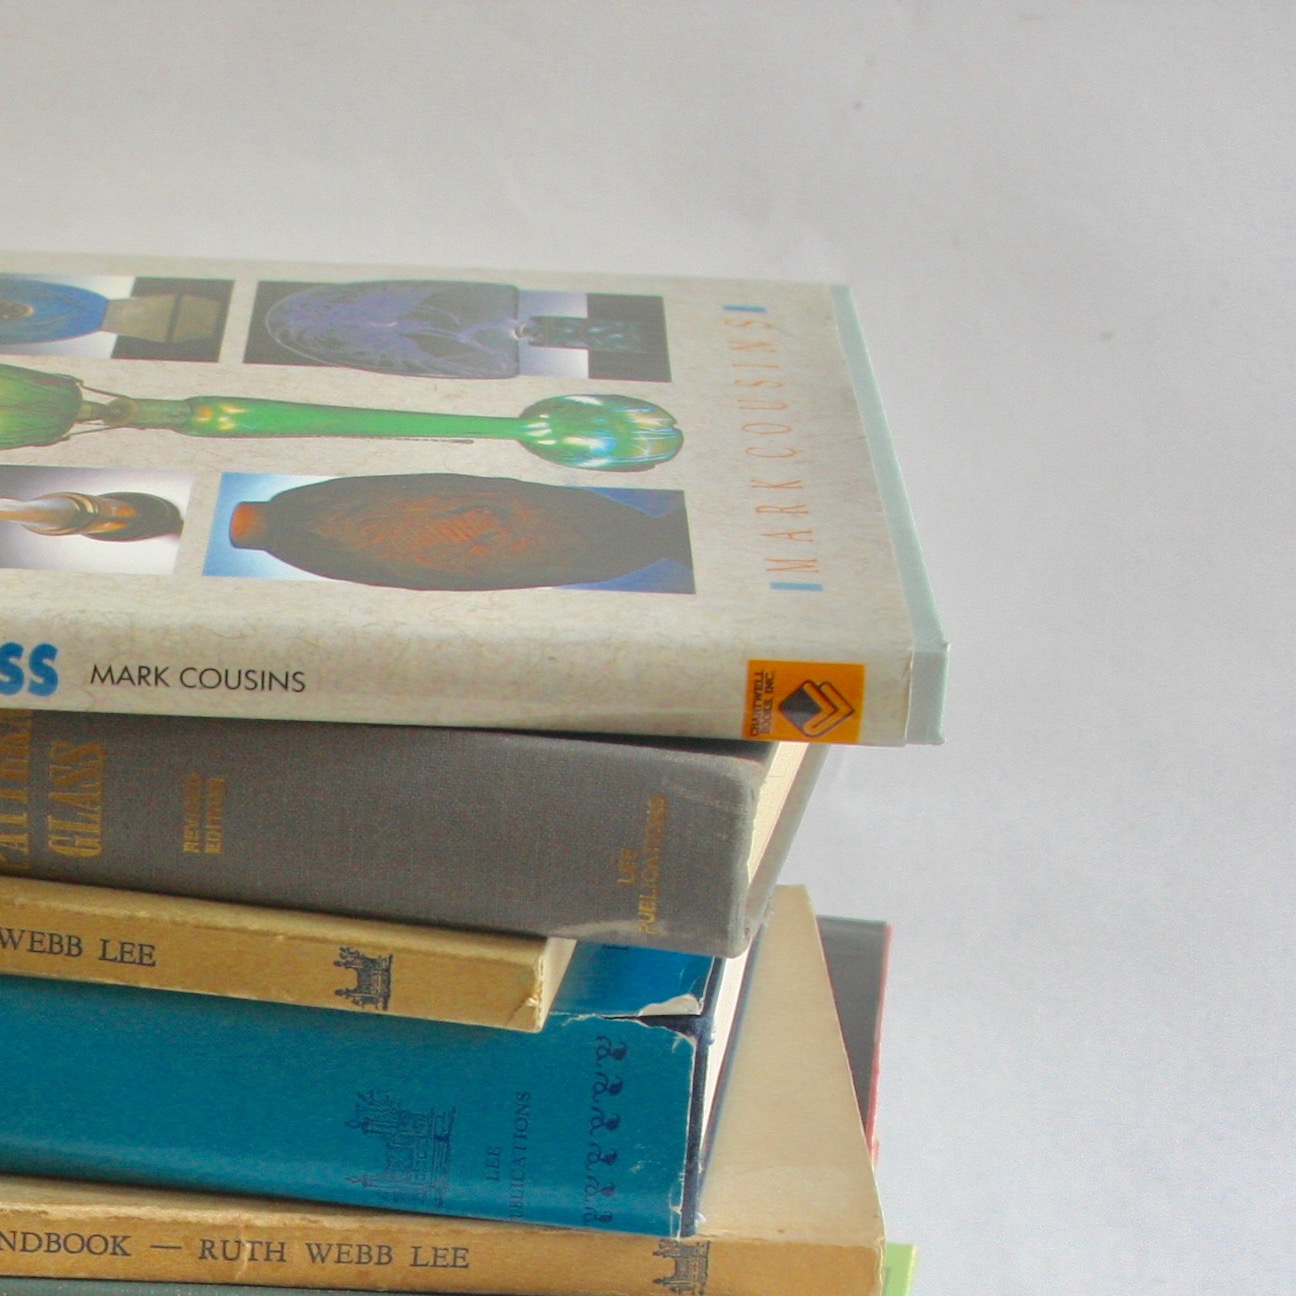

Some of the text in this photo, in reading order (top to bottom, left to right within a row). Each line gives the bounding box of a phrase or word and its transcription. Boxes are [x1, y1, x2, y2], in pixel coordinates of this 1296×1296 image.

[724, 317, 820, 573] MARK COUSINS
[90, 663, 170, 691] MARK
[179, 665, 306, 696] COUSINS
[47, 740, 107, 860] GLASS
[98, 938, 158, 968] LEE
[485, 1144, 502, 1181] LEE
[508, 1090, 532, 1220] UBLICATIONS
[198, 1238, 287, 1264] RUTH
[306, 1242, 394, 1267] WEBB
[410, 1244, 471, 1269] LEE
